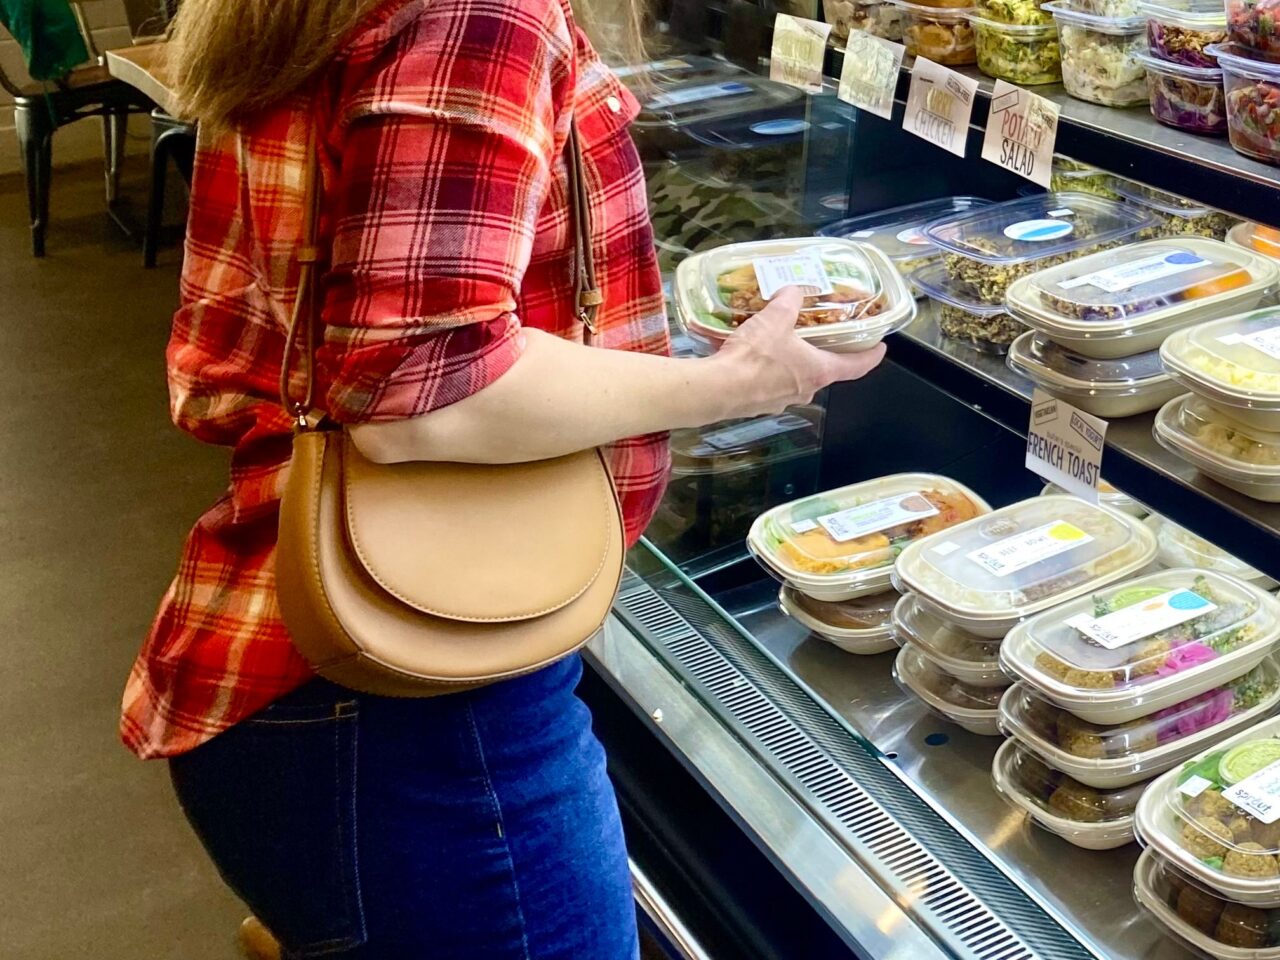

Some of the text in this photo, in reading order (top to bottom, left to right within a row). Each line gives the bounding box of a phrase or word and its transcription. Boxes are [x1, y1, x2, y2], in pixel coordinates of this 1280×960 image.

[915, 109, 956, 148] CHICKEN
[1000, 141, 1035, 176] SALAD
[1028, 432, 1064, 471] FRENCH
[1068, 451, 1099, 489] TOAST
